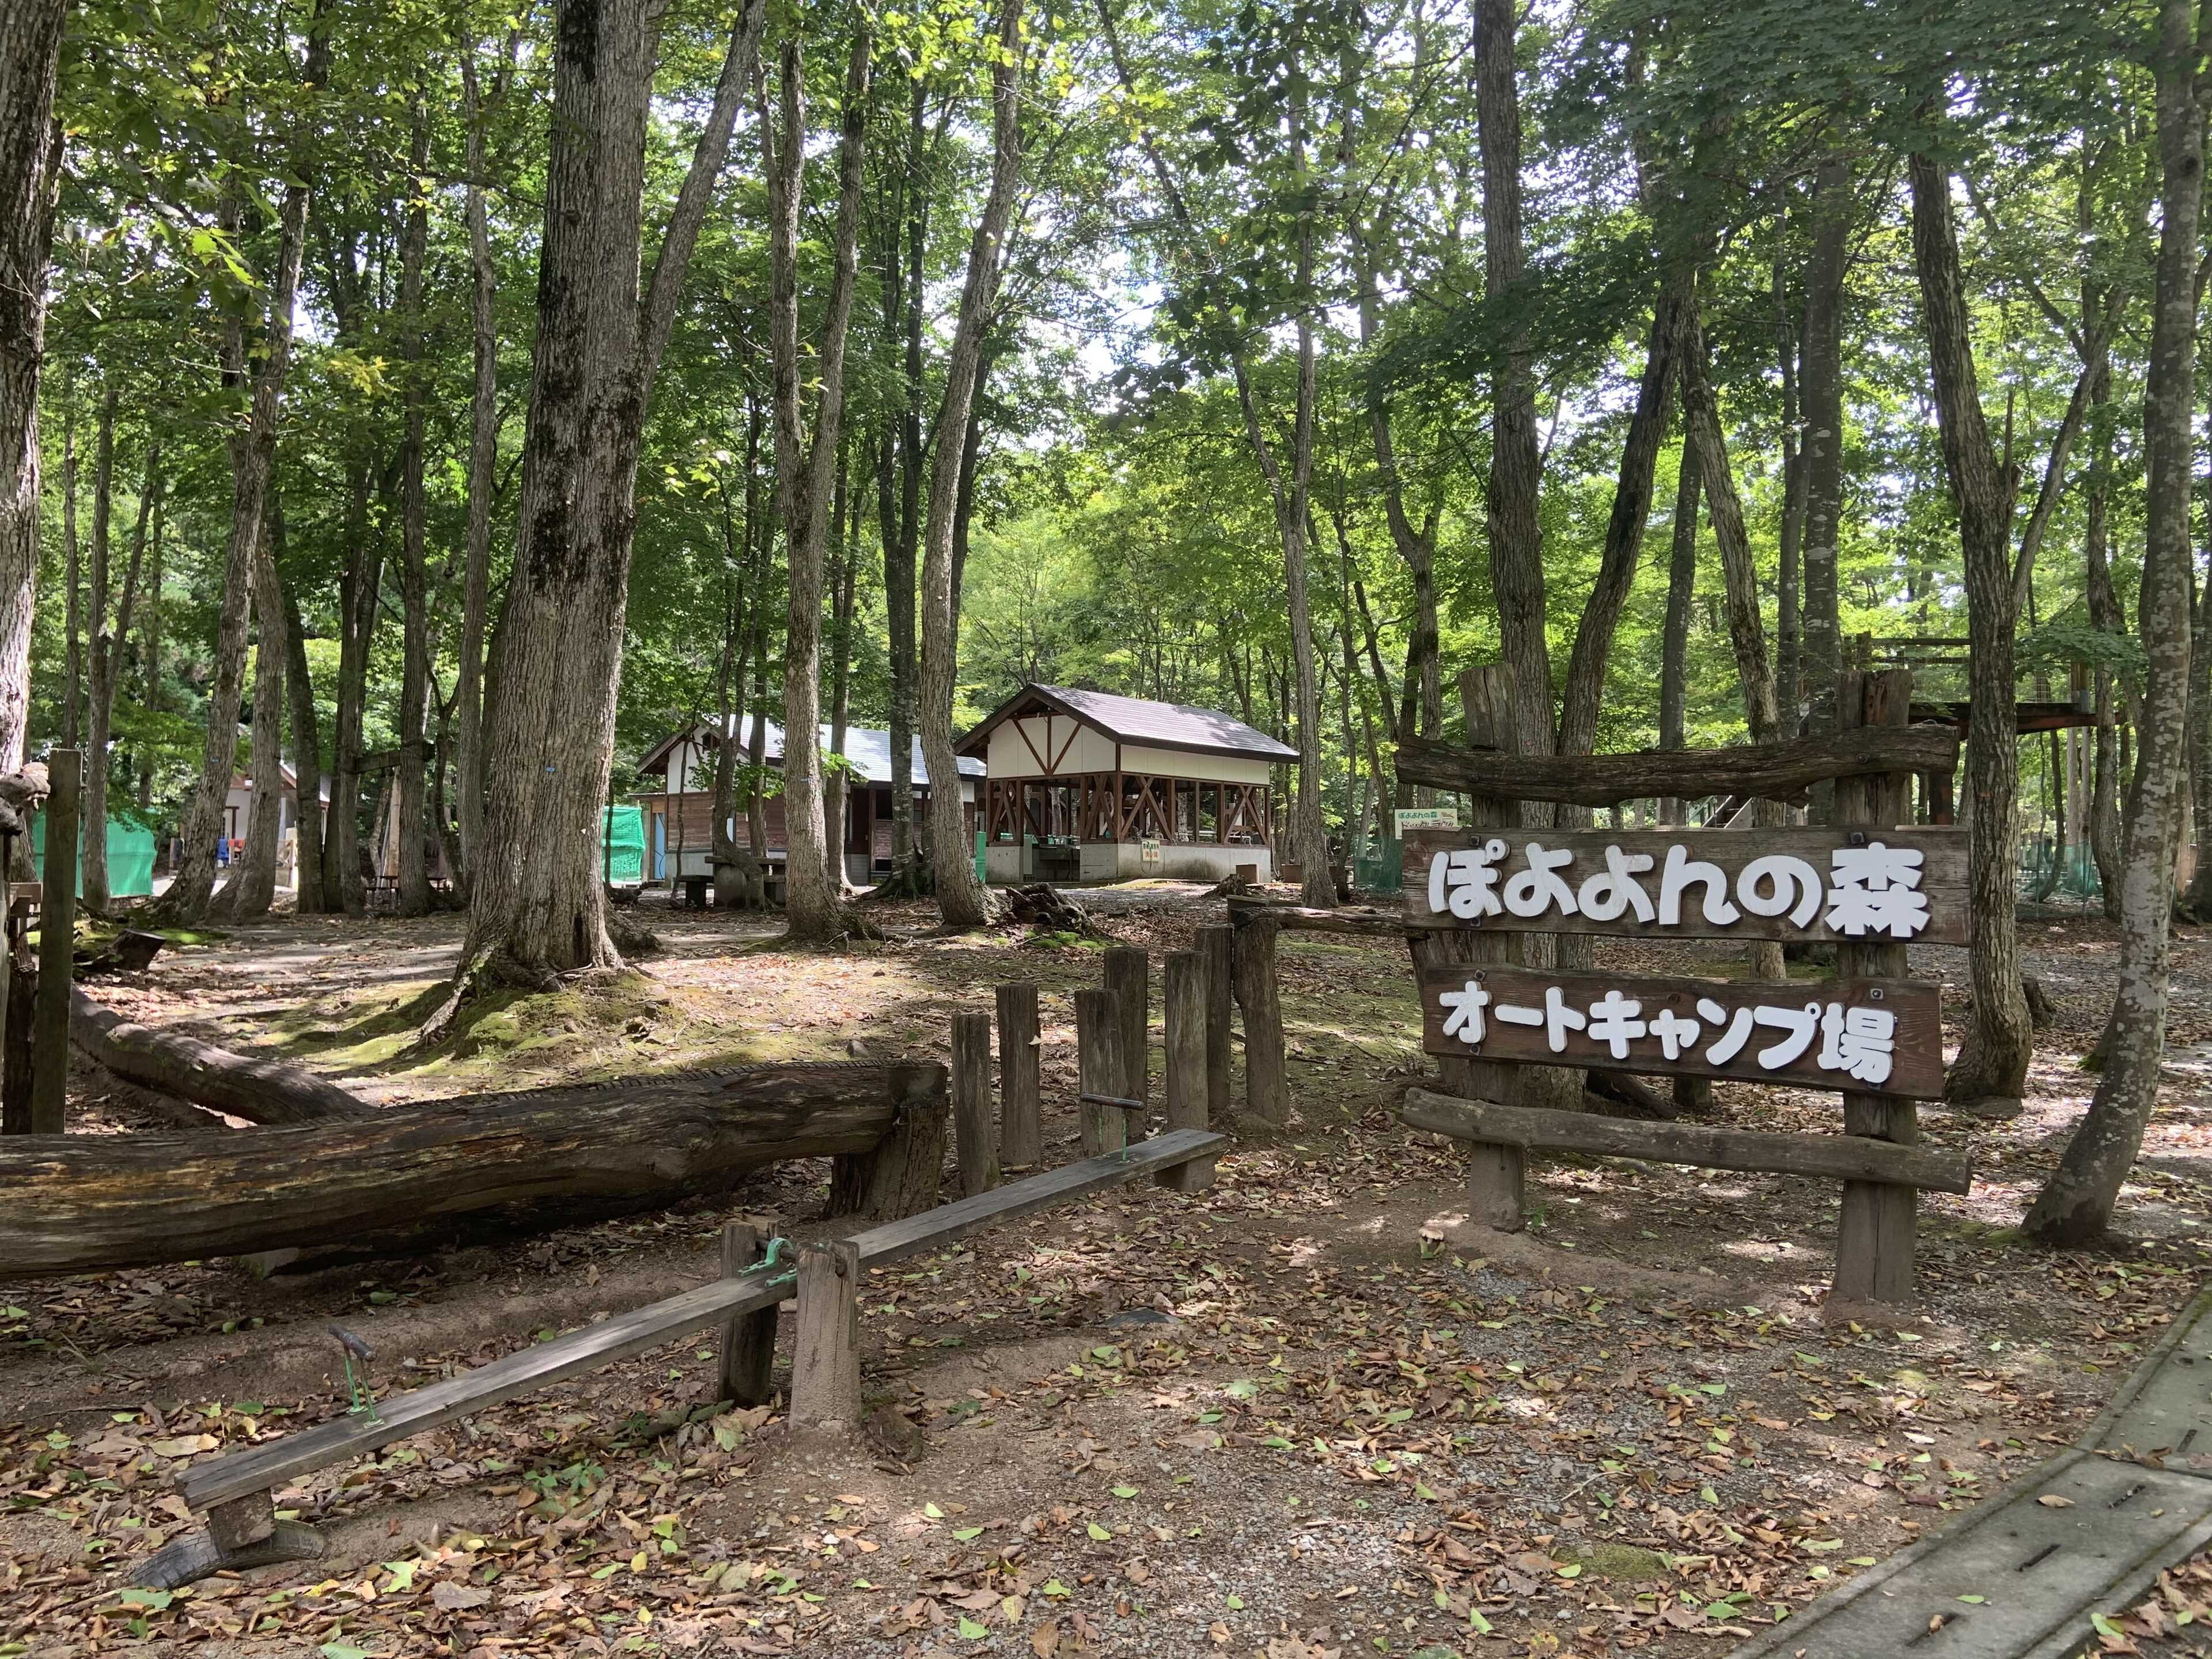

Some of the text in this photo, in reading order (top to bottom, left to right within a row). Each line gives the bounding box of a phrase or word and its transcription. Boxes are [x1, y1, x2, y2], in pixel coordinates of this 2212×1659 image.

[1398, 811, 1438, 819] ぽよよんの森
[1428, 838, 1931, 938] ぽよよんの森
[1439, 980, 1895, 1084] オートキャンプ場
